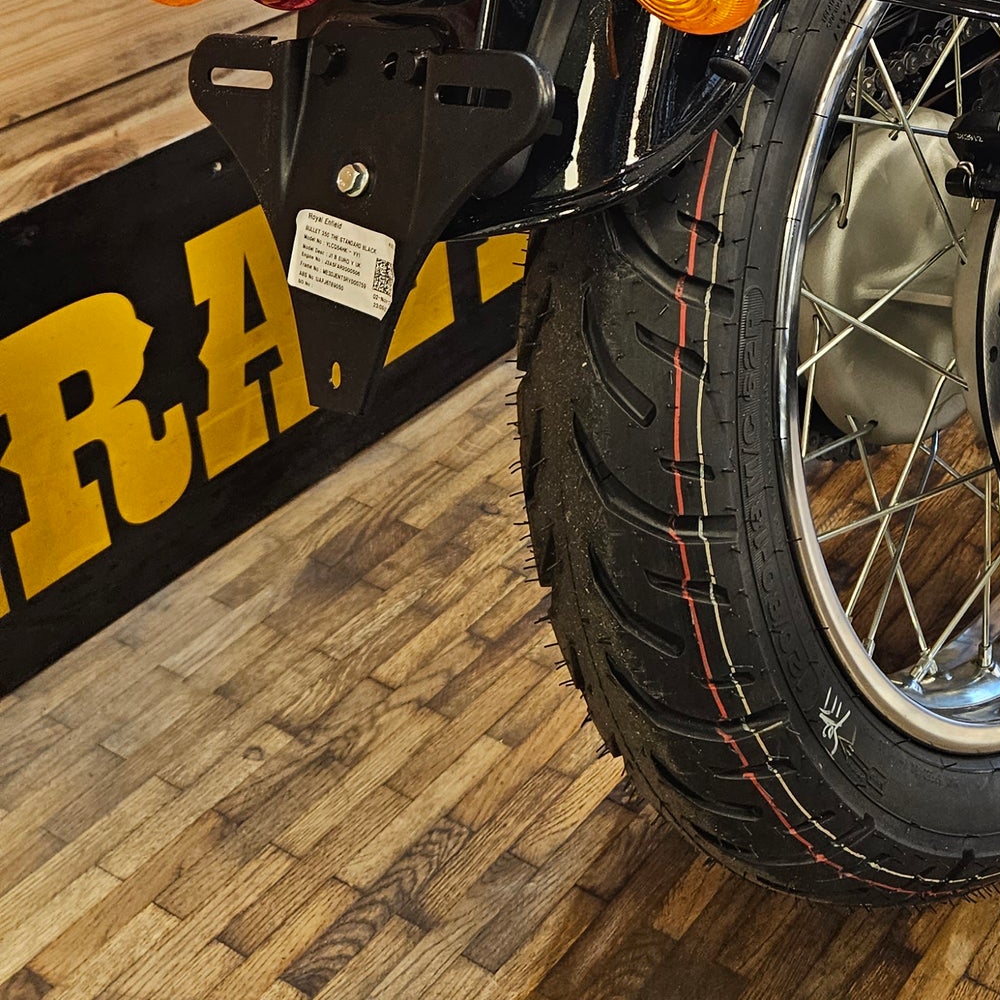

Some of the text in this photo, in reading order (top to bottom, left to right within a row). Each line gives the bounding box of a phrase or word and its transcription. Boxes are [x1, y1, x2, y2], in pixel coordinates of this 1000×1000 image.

[308, 212, 342, 229] Royal Enfield
[362, 244, 377, 254] BLACK
